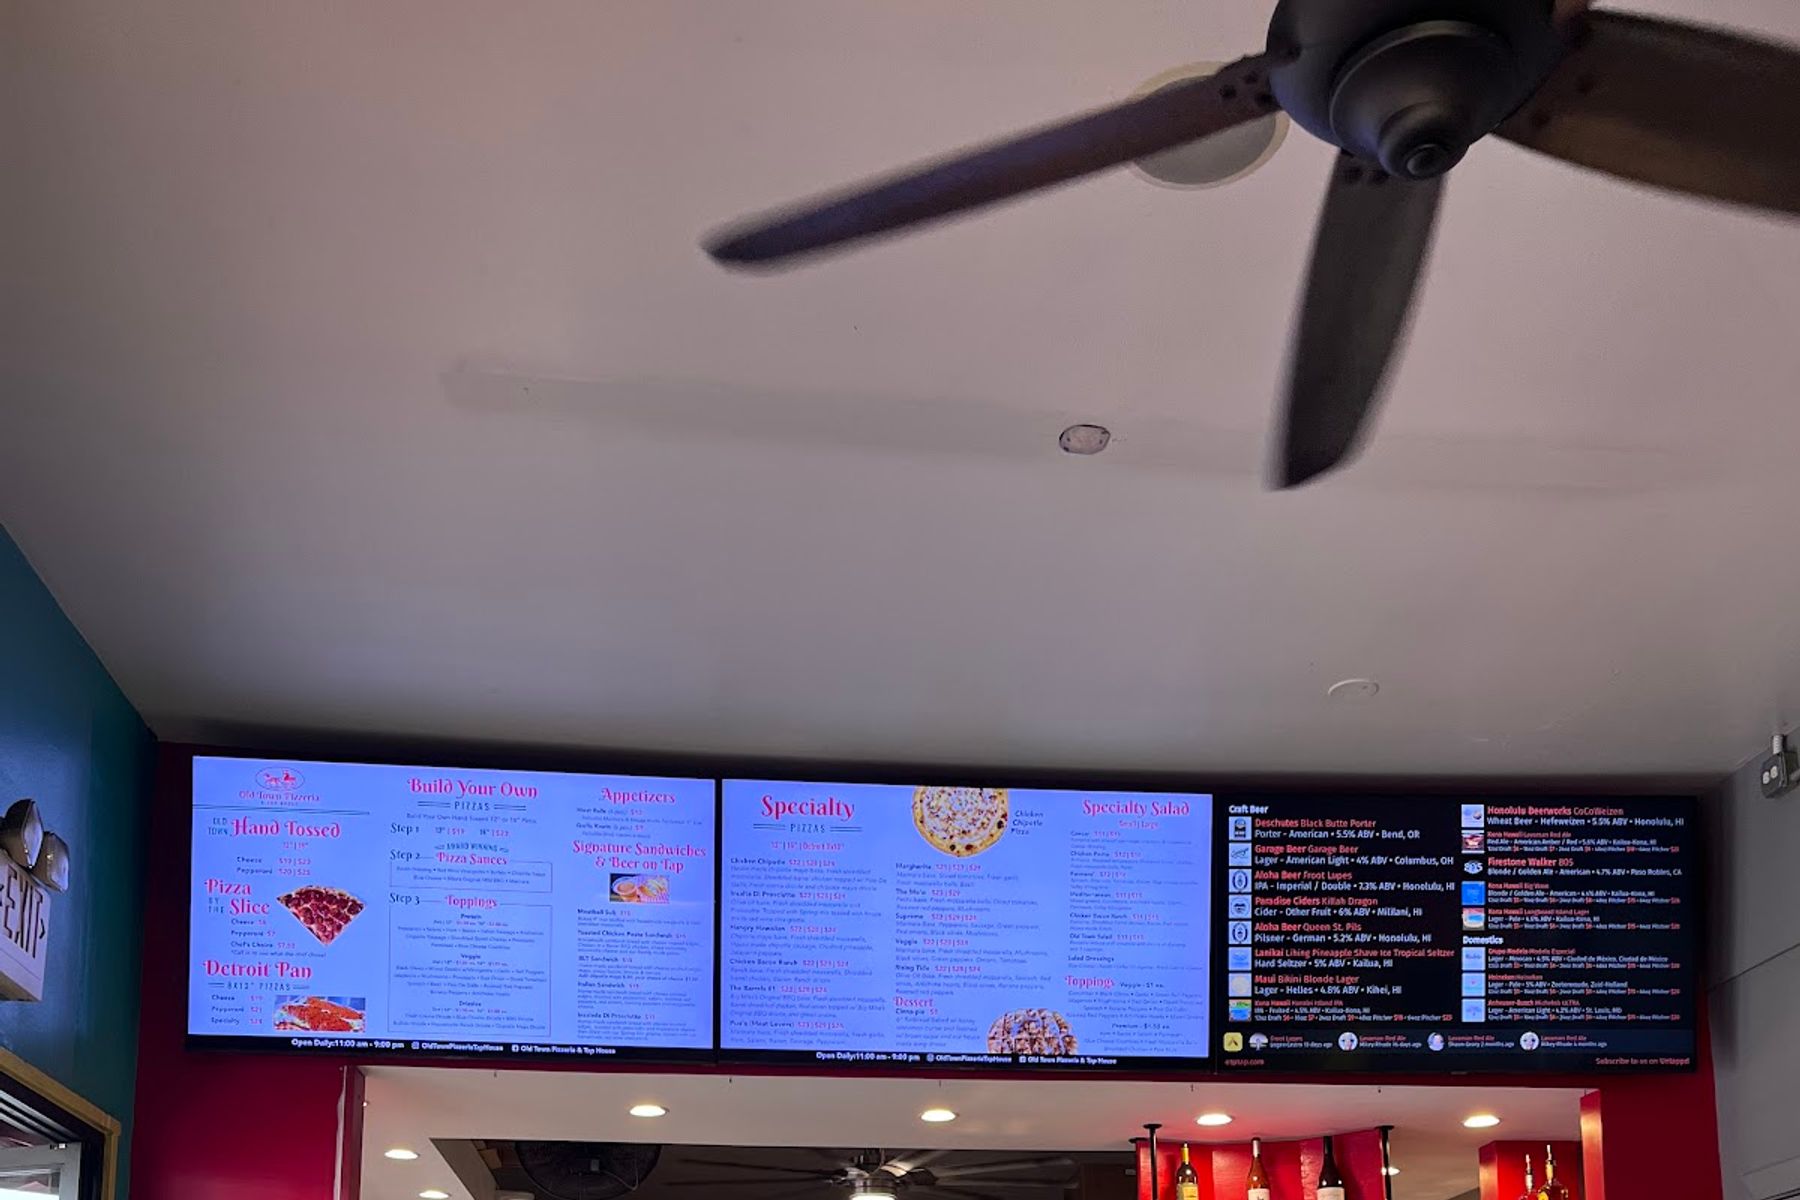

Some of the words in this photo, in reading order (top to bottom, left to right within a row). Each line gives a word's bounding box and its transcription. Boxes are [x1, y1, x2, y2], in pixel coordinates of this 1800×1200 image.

[407, 778, 453, 793] Build
[456, 780, 496, 798] Your
[500, 783, 537, 798] Own
[601, 788, 675, 804] Appetizers
[454, 802, 490, 811] PIZZAS
[761, 795, 855, 821] Specialty
[1083, 800, 1147, 818] Specialty
[1151, 801, 1189, 816] Salad
[1229, 805, 1248, 814] Craft
[1250, 805, 1269, 814] Beer
[1487, 806, 1526, 815] Honolulu
[1528, 806, 1571, 815] Beerworks
[231, 818, 280, 837] Hand
[284, 821, 341, 837] Tossed
[1255, 818, 1299, 828] Deschutes
[1301, 819, 1323, 828] Black
[1325, 820, 1348, 828] Butte
[1350, 820, 1376, 828] Porter
[1487, 817, 1512, 825] Wheat
[1635, 818, 1674, 827] Honolulu,
[391, 822, 412, 835] Step
[791, 824, 825, 833] PIZZAS
[1255, 830, 1281, 838] Porter
[1289, 831, 1328, 839] American
[1357, 831, 1374, 839] ABV
[1382, 830, 1406, 839] Bend,
[1407, 830, 1420, 838] OR
[573, 840, 632, 855] Signature
[635, 842, 706, 857] Sandwiches
[1255, 845, 1284, 855] Garage
[1286, 845, 1306, 853] Beer
[1308, 845, 1337, 855] Garage
[1339, 846, 1358, 854] Beer
[390, 850, 412, 862] Step
[436, 852, 467, 863] Pizza
[470, 853, 508, 865] Sauces
[1255, 856, 1278, 866] Lager
[1286, 856, 1326, 865] American
[1328, 857, 1349, 866] Light
[1356, 857, 1369, 865] 4%
[1370, 857, 1388, 865] ABV
[1395, 857, 1439, 866] Columbus,
[1488, 857, 1526, 866] Firestone
[1528, 858, 1557, 866] Walker
[595, 857, 605, 867] &
[609, 857, 639, 869] Beer
[643, 860, 657, 870] on
[661, 860, 684, 873] Tap
[1255, 870, 1279, 879] Aloha
[1281, 871, 1301, 879] Beer
[1304, 872, 1325, 880] Froot
[1328, 872, 1352, 881] Lupes
[205, 879, 251, 895] Pizza
[1255, 882, 1268, 890] IPA
[1277, 882, 1312, 891] Imperial
[1379, 882, 1396, 890] ABV
[1402, 882, 1444, 892] Honolulu,
[1446, 882, 1455, 890] HI
[390, 893, 412, 905] Step
[415, 897, 420, 905] 3
[446, 896, 497, 909] Toppings
[1255, 896, 1291, 906] Paradise
[1293, 897, 1320, 906] Ciders
[1322, 897, 1346, 905] Killah
[1348, 898, 1378, 907] Dragon
[3, 864, 43, 958] EXIT
[229, 900, 270, 915] Slice
[1255, 908, 1277, 916] Cider
[1286, 908, 1310, 916] Other
[1311, 908, 1331, 916] Fruit
[1338, 908, 1352, 916] 6%
[1354, 908, 1370, 916] ABV
[1413, 908, 1422, 916] HI
[1255, 923, 1279, 931] Aloha
[1281, 923, 1301, 931] Beer
[1303, 924, 1330, 932] Queen
[1346, 923, 1362, 931] Pils
[1255, 949, 1284, 957] Lanikai
[1312, 950, 1352, 959] Pineapple
[1393, 949, 1425, 958] Tropical
[203, 960, 270, 977] Detroit
[275, 962, 311, 979] Pan
[1065, 976, 1114, 989] Toppings
[1255, 975, 1276, 983] Maui
[1278, 975, 1301, 983] Bikini
[1304, 975, 1334, 983] Blonde
[1336, 976, 1359, 985] Lager
[893, 997, 933, 1007] Dessert
[292, 1039, 312, 1047] Open
[374, 1040, 390, 1048] 9:00
[391, 1042, 404, 1050] pm
